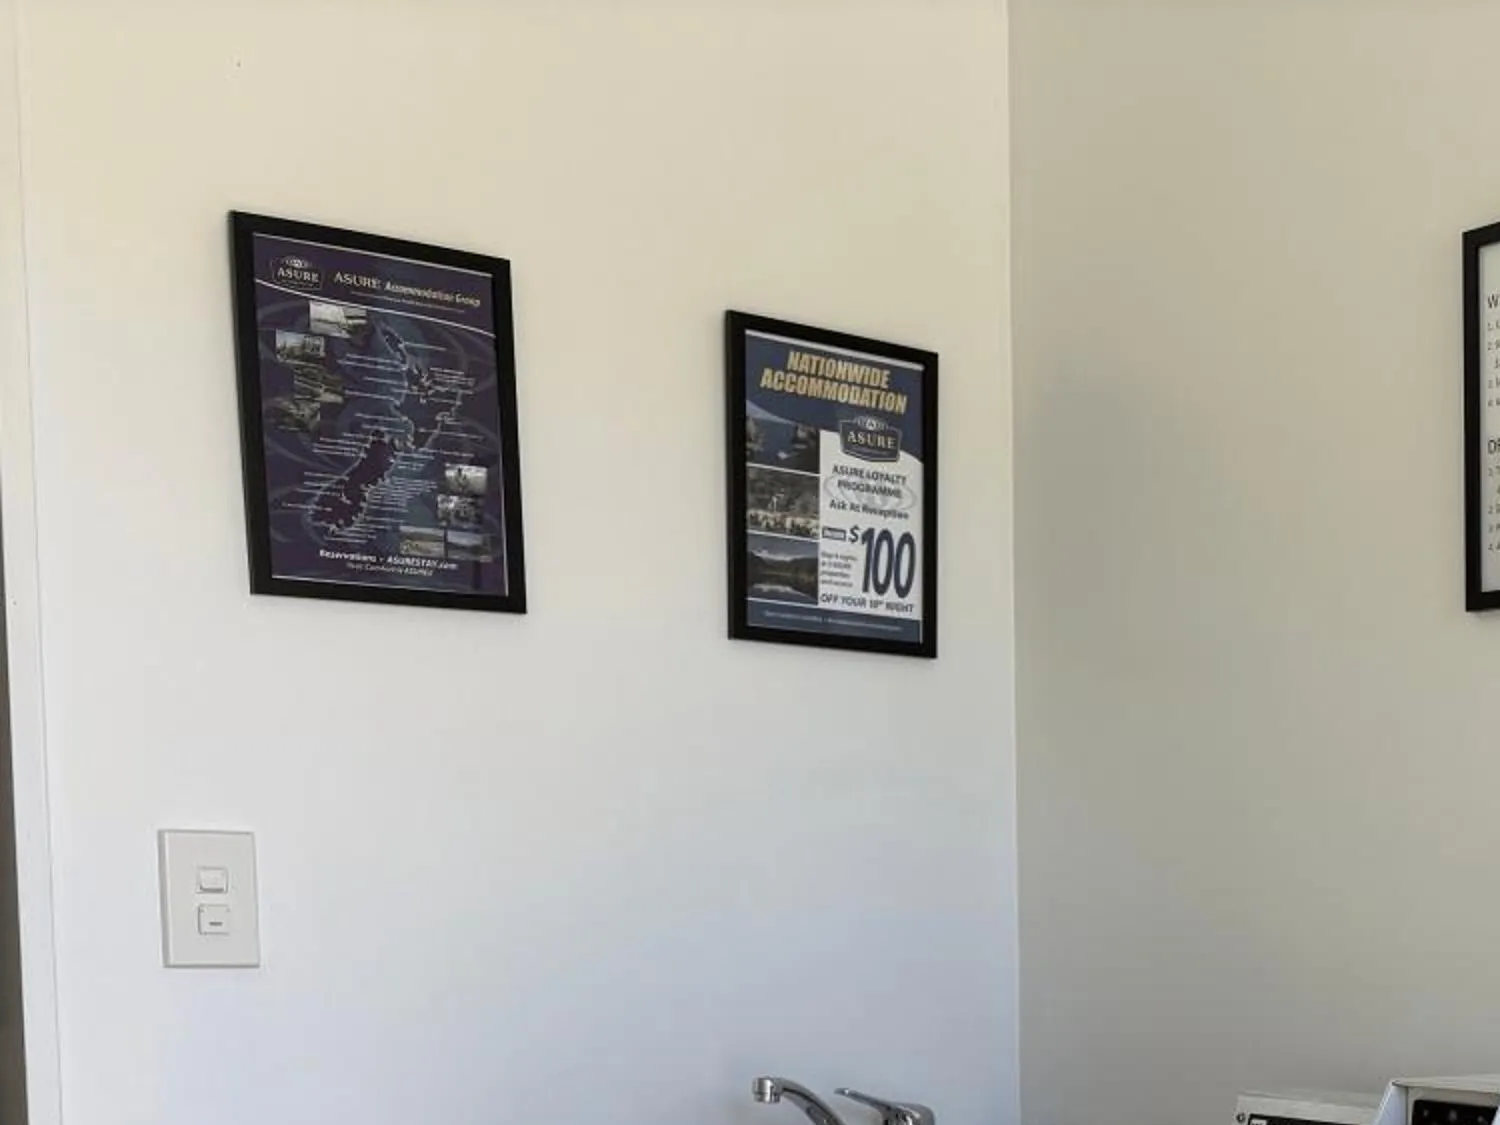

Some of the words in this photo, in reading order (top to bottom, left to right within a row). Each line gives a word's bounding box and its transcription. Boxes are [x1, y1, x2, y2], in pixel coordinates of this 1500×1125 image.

[333, 271, 380, 290] ASURE
[787, 350, 891, 389] NATIONWIDE
[759, 368, 908, 416] ACCOMMODATION
[847, 430, 896, 449] ASURE
[832, 465, 865, 481] ASURE
[865, 468, 906, 486] LOYALTY
[849, 524, 916, 599] $100
[821, 592, 838, 605] OFF
